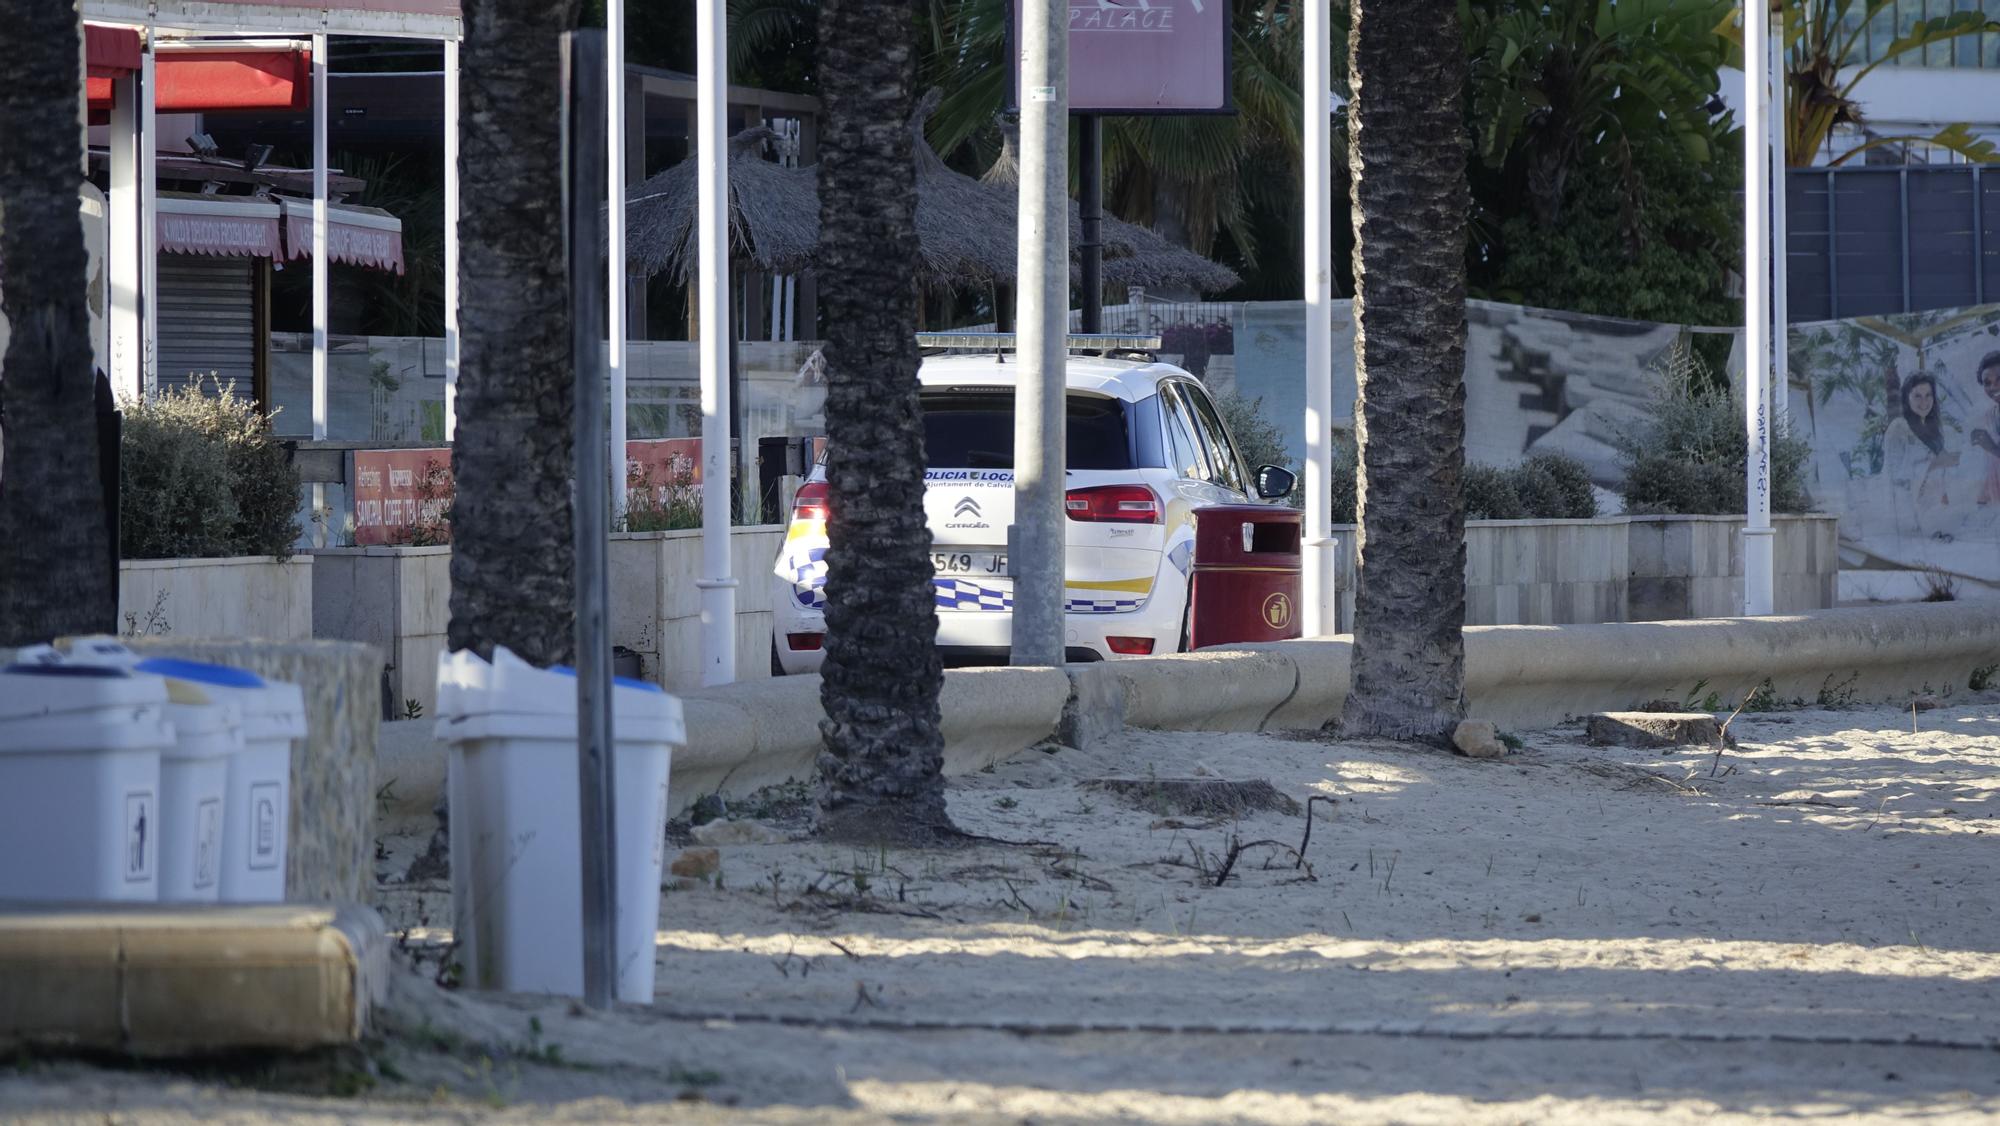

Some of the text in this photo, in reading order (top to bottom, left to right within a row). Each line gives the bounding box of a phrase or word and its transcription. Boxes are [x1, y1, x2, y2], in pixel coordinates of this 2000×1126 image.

[1068, 9, 1173, 28] PALACE
[924, 471, 1015, 481] OLICIA LOCA
[928, 553, 1008, 573] 549 JF
